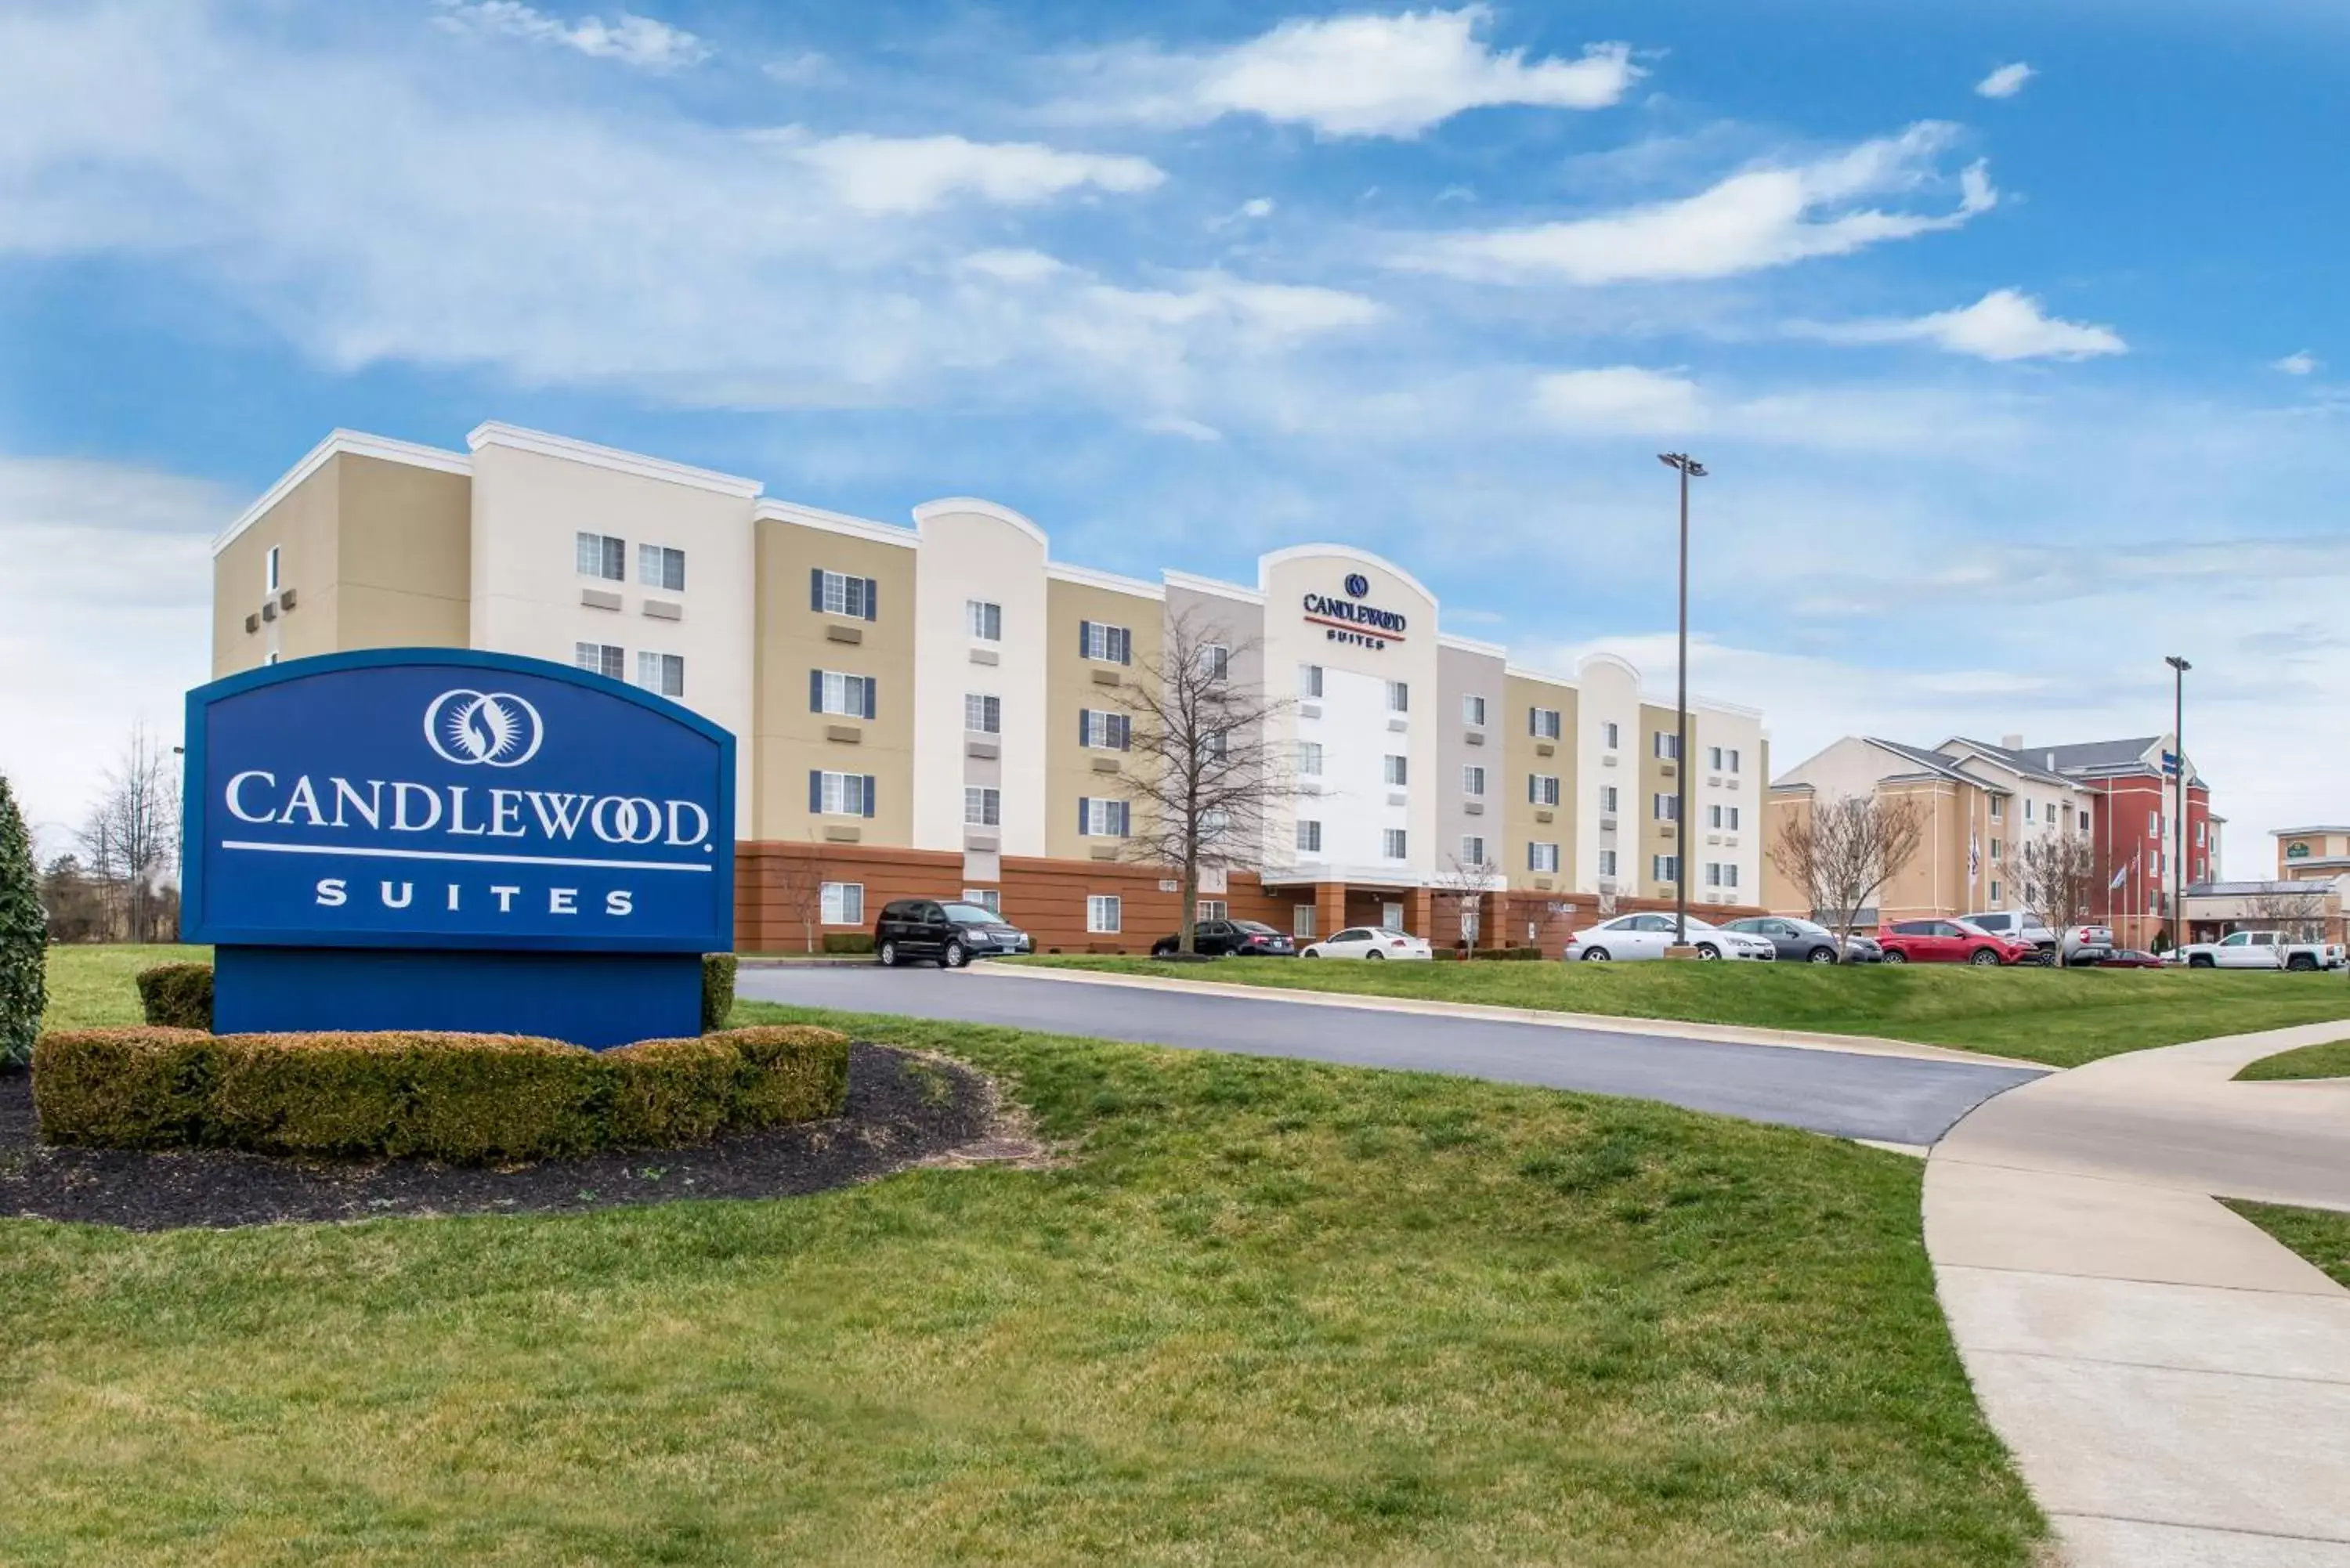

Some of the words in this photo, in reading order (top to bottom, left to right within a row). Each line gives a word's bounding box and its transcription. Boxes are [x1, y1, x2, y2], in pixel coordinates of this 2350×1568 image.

[1303, 593, 1407, 633] CANDLEWOOD
[1326, 629, 1385, 651] SUITES
[315, 878, 634, 916] SUITES
